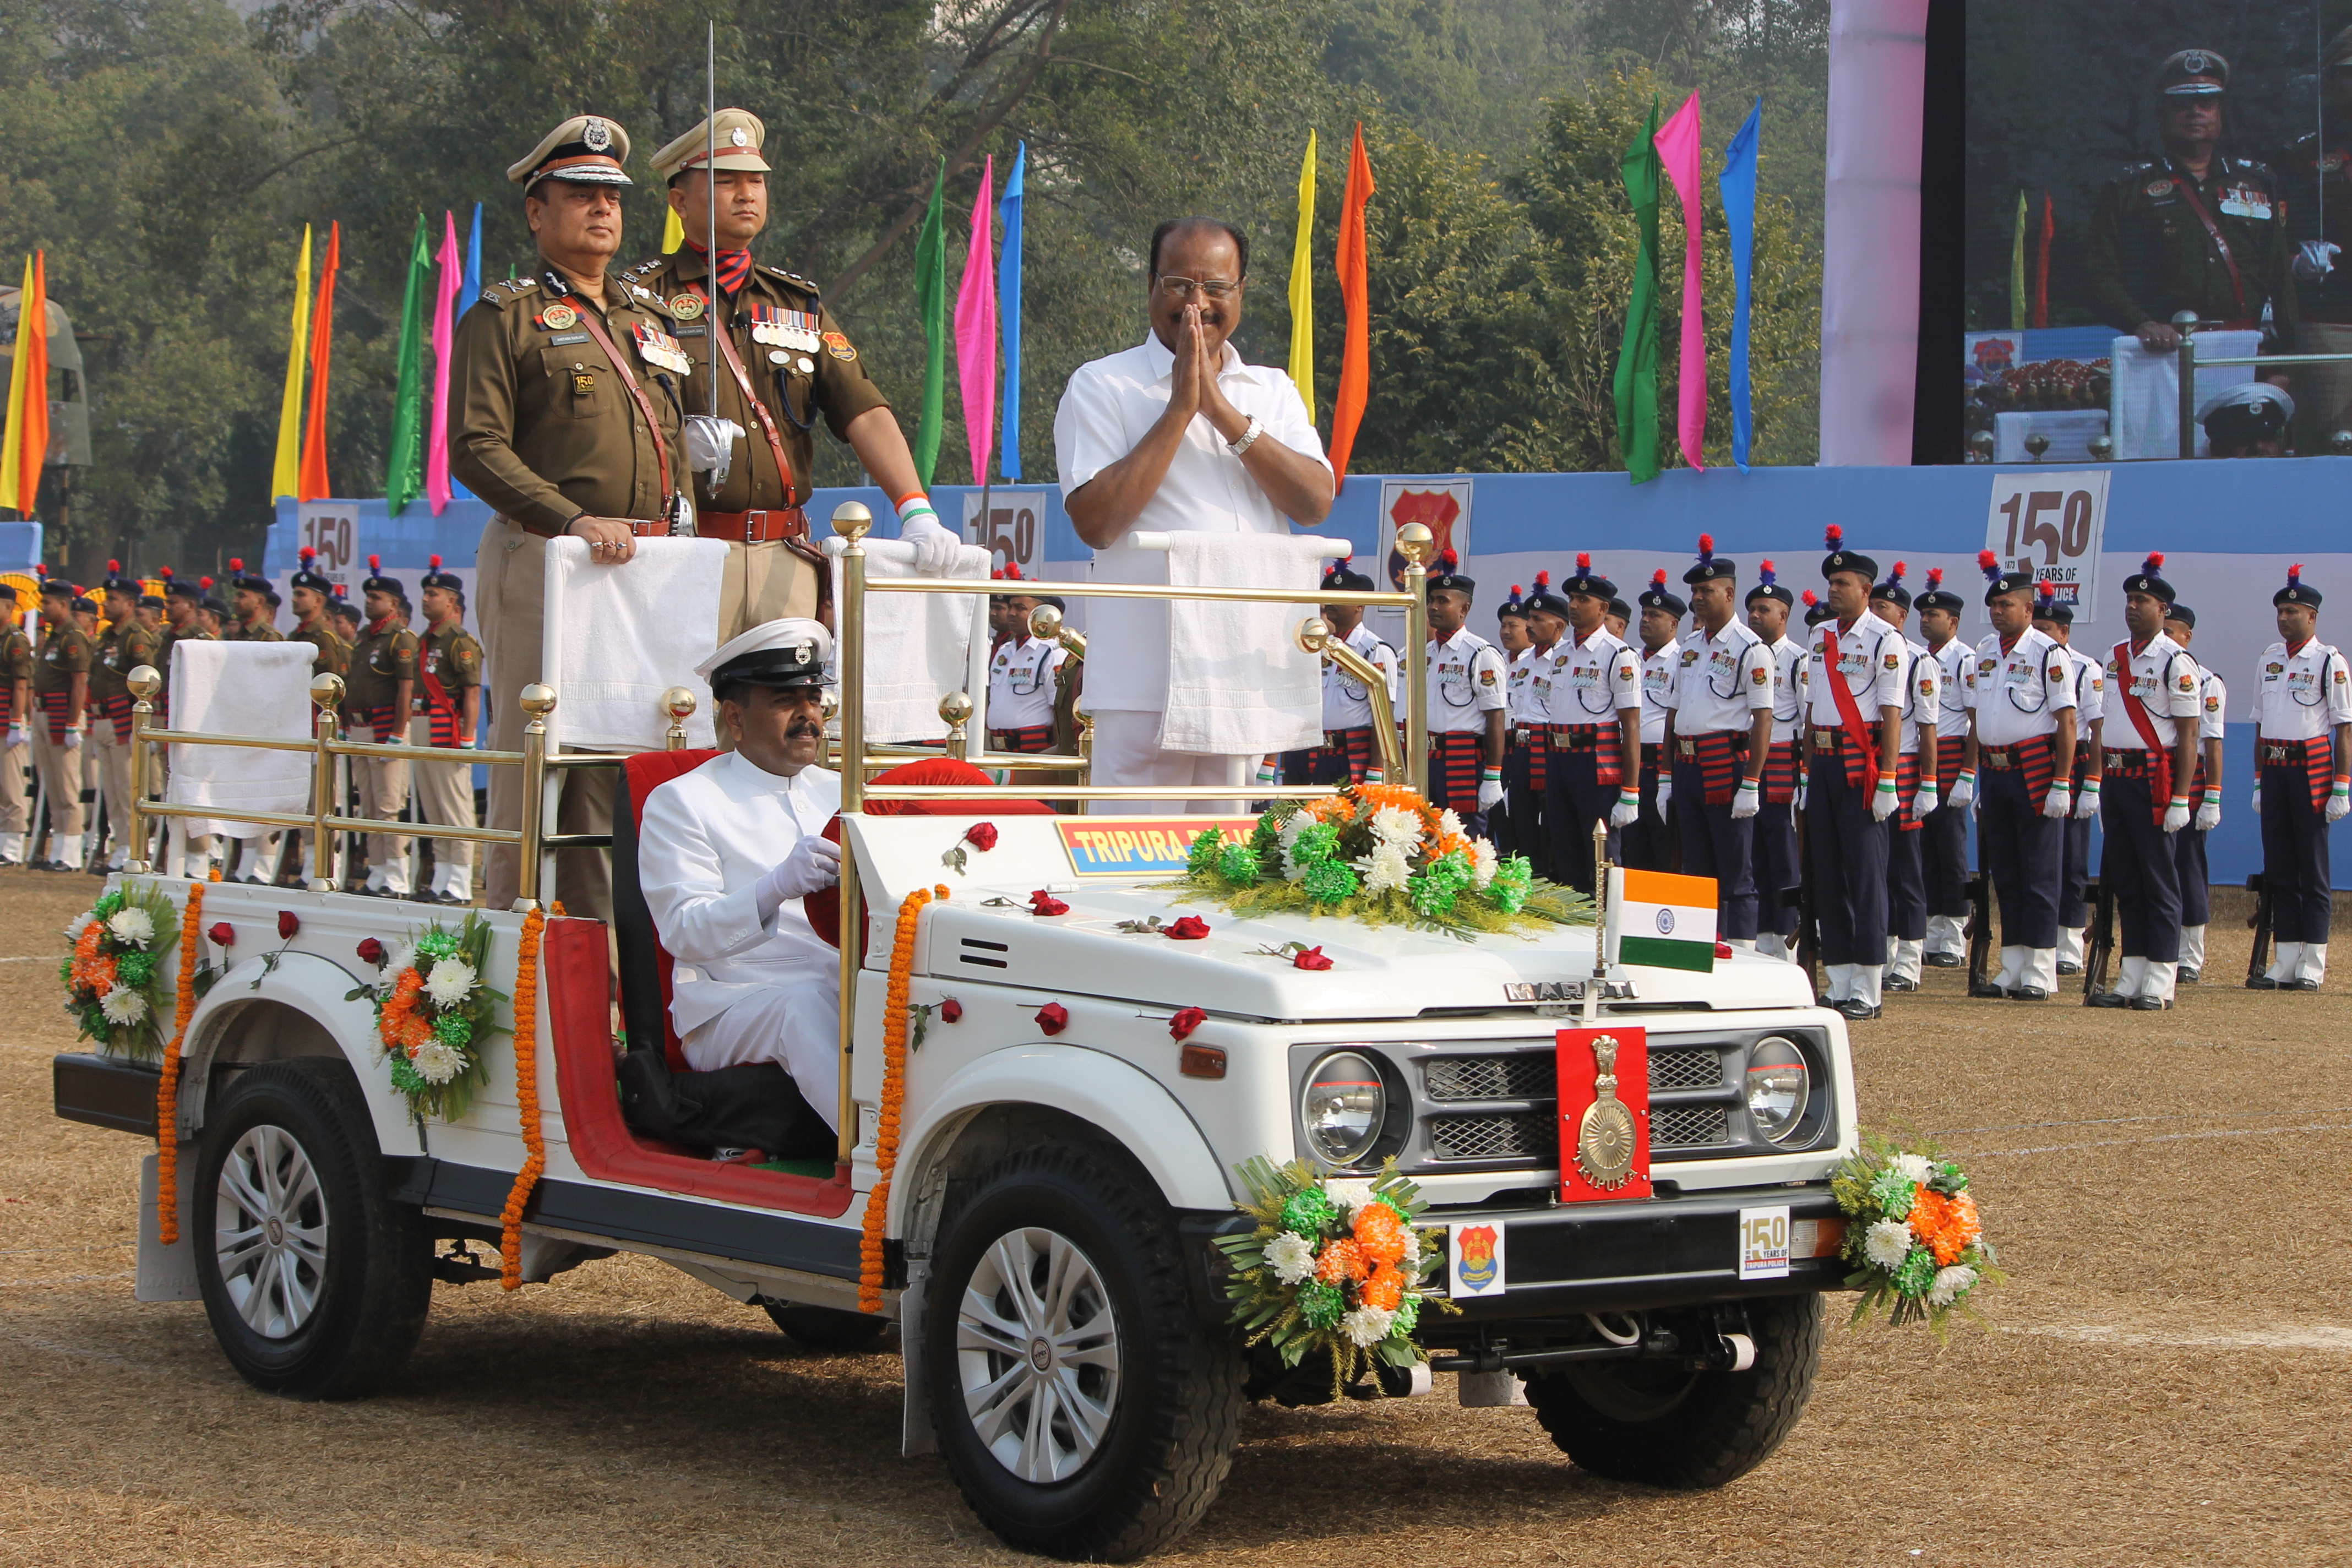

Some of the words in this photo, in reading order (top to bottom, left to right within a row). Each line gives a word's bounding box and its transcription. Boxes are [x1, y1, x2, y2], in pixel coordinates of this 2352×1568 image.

[575, 375, 594, 389] 150
[2000, 489, 2092, 576] 150
[304, 517, 351, 577] 150
[2004, 560, 2015, 569] 1873
[2035, 568, 2063, 581] YEARS
[2065, 567, 2077, 581] OF
[2052, 587, 2074, 601] LICE
[1074, 829, 1189, 863] TRIPURA
[1572, 1143, 1638, 1192] TRIPURA
[1741, 1215, 1785, 1260] 150
[1763, 1250, 1780, 1259] YEARS
[1781, 1249, 1788, 1257] OF
[1746, 1261, 1767, 1269] TRIPURA
[1767, 1259, 1785, 1267] POLICE
[140, 1277, 195, 1288] MARU
